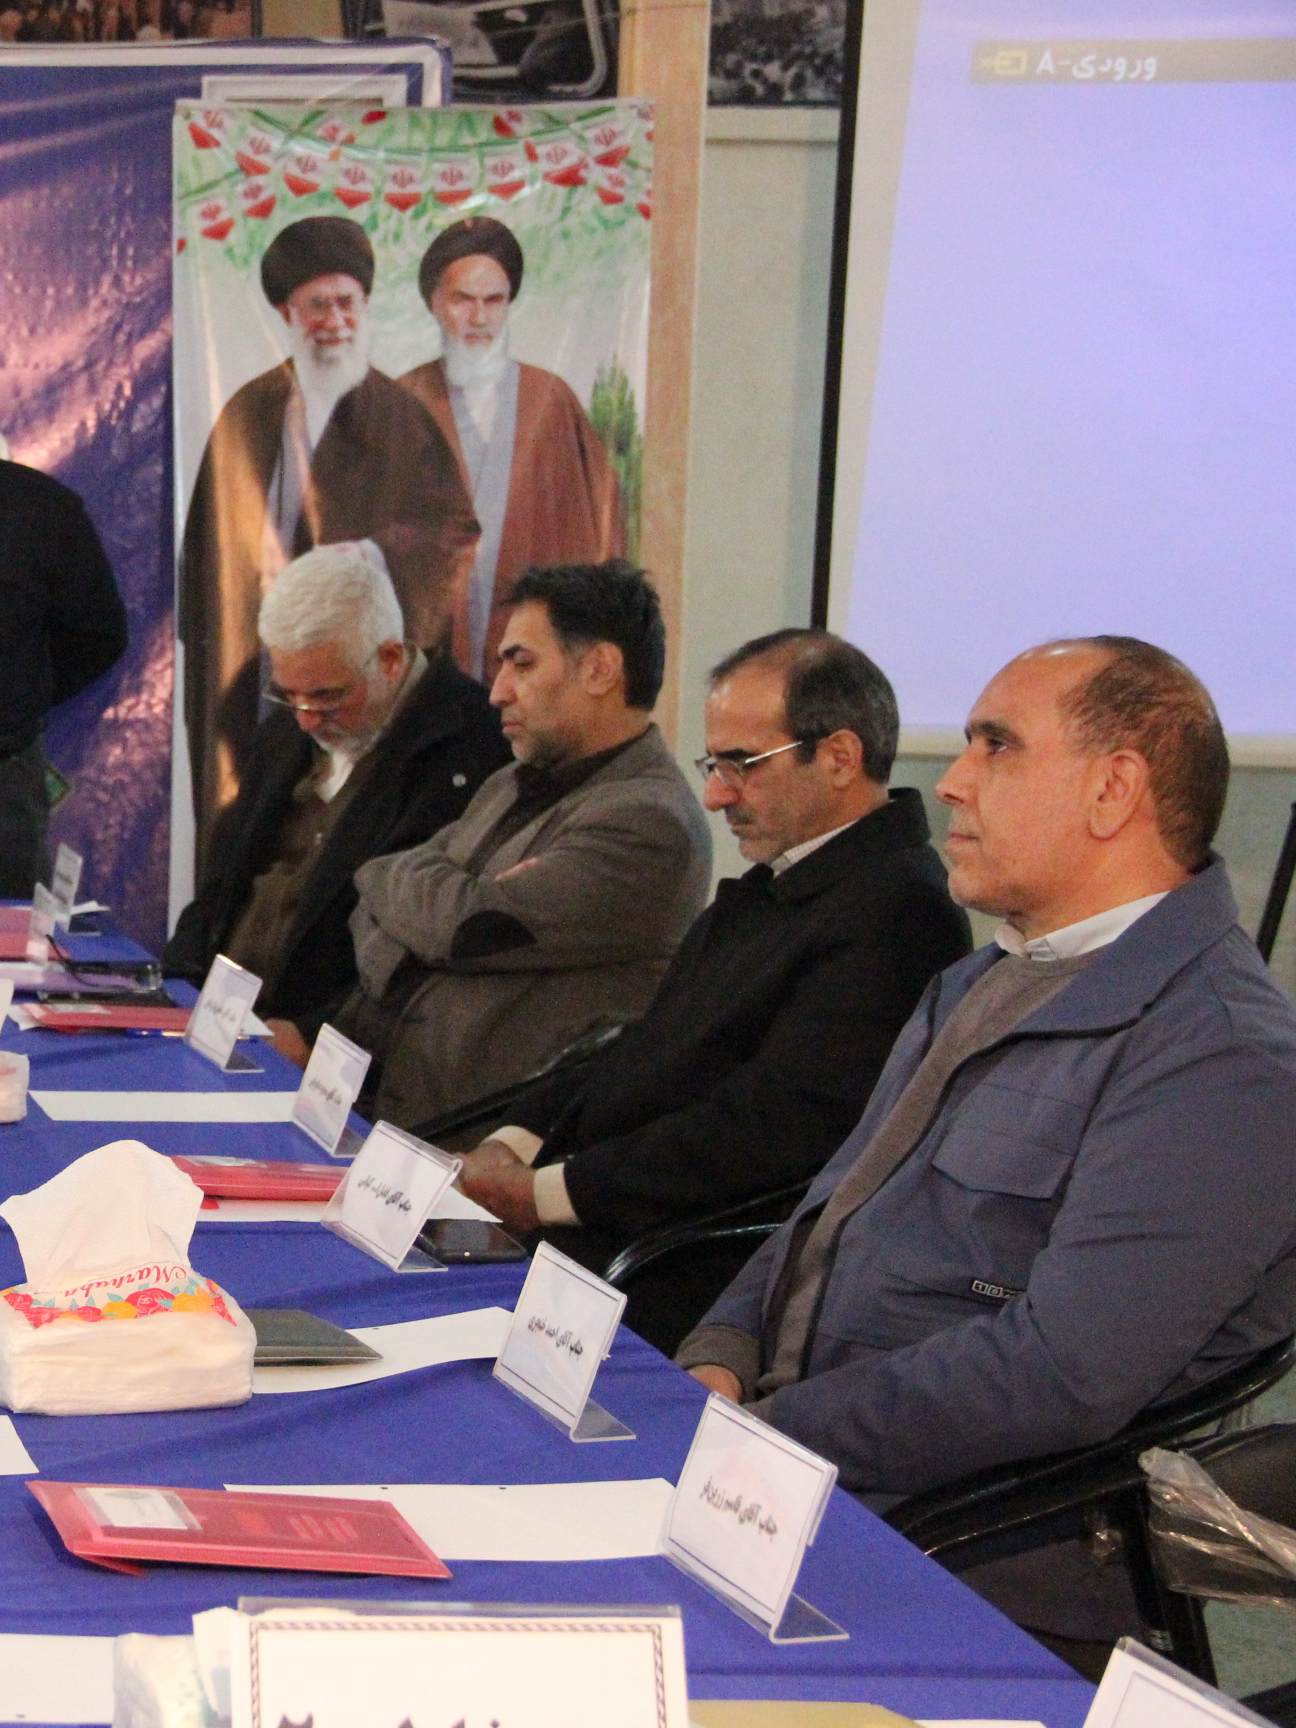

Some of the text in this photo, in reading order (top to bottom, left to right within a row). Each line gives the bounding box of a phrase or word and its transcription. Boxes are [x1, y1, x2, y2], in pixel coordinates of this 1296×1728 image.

[63, 1264, 188, 1298] Marhaba
[556, 1331, 572, 1348] آقای
[569, 1339, 584, 1361] جناب
[738, 1503, 762, 1525] آقای
[758, 1513, 778, 1542] جناب
